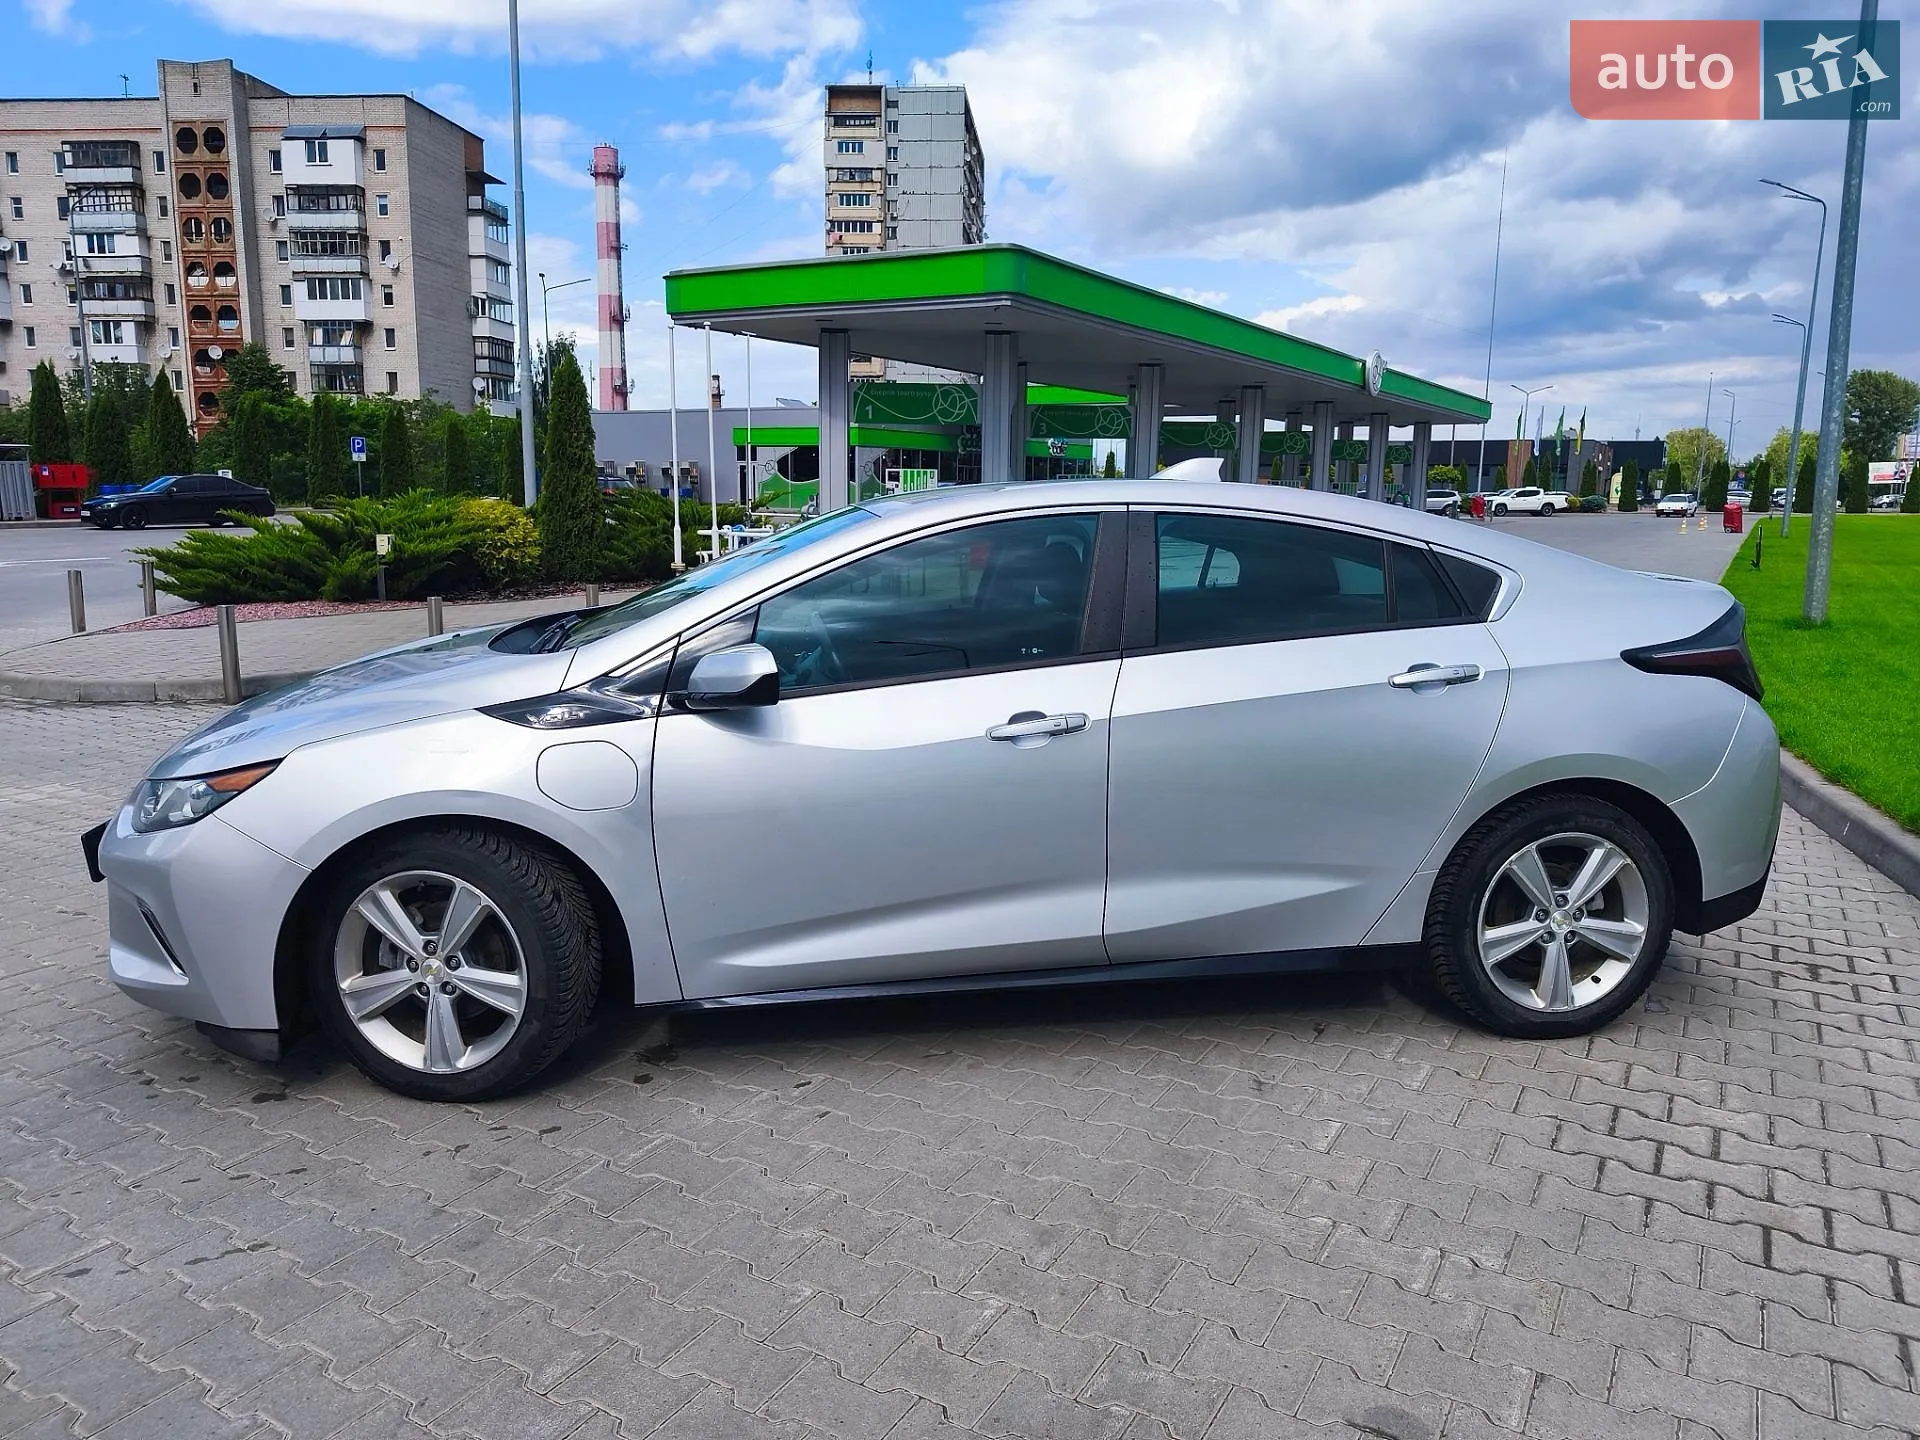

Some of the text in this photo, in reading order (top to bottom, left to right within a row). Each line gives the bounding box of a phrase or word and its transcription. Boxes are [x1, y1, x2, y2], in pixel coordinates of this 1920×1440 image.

[865, 405, 873, 420] 1
[1039, 422, 1047, 435] 3
[354, 440, 363, 452] P
